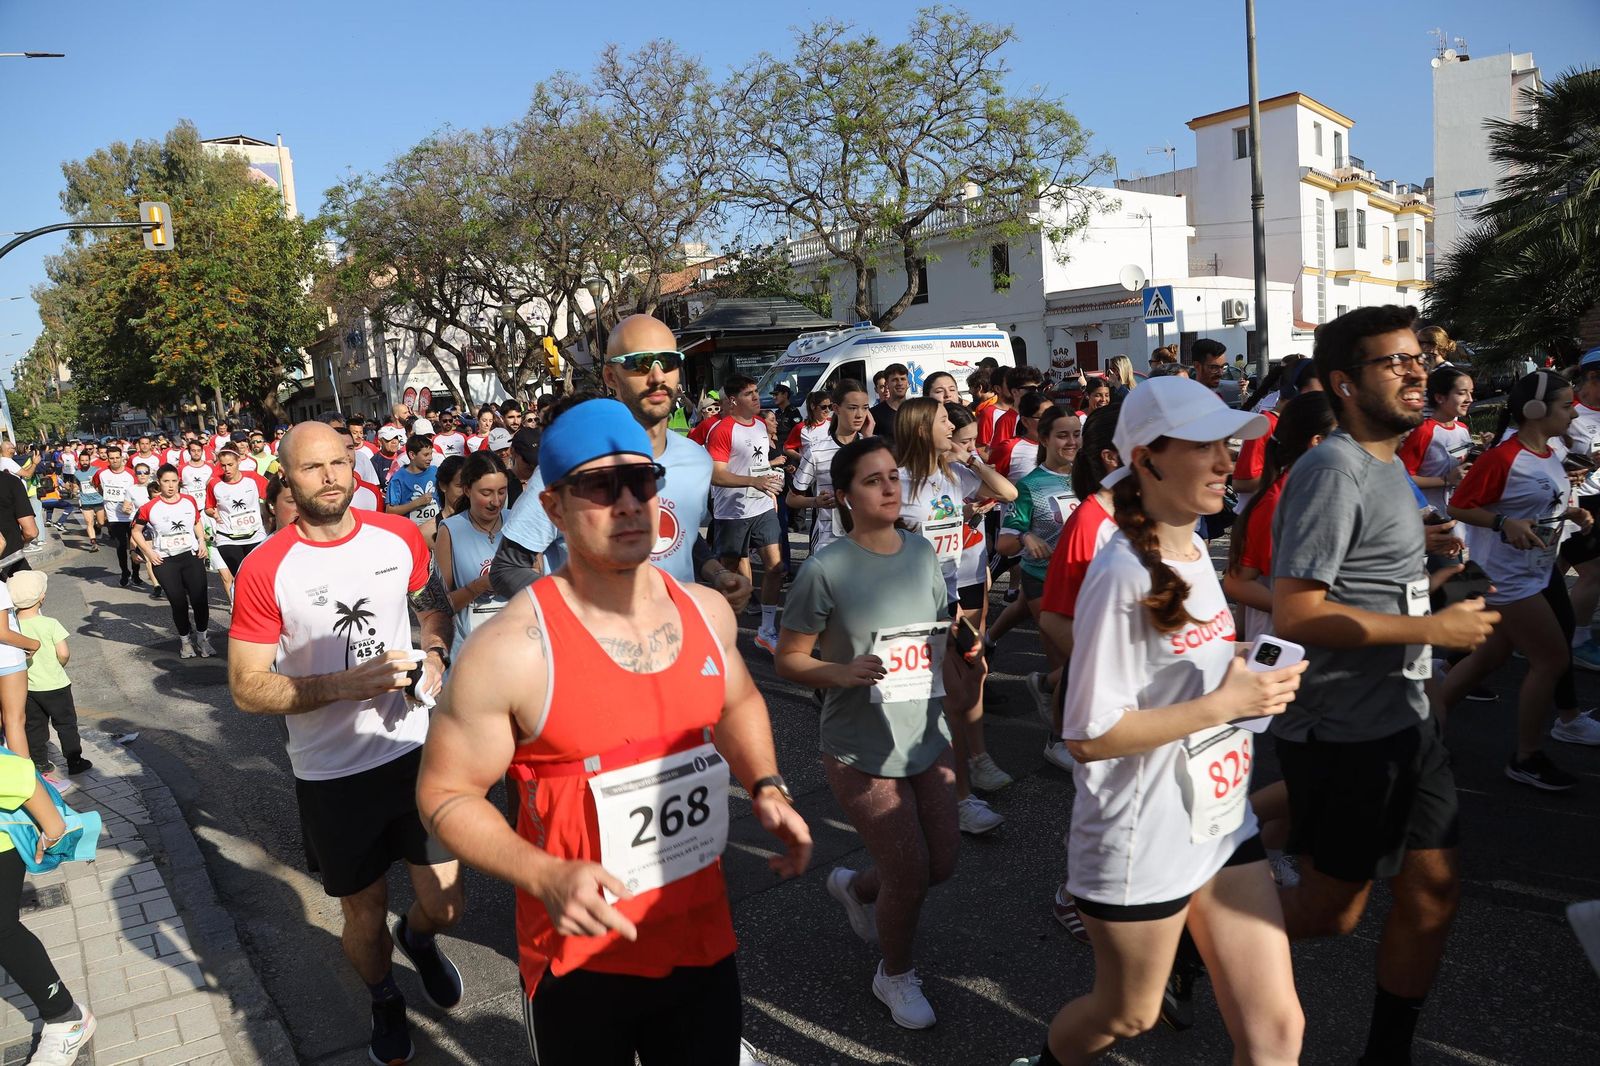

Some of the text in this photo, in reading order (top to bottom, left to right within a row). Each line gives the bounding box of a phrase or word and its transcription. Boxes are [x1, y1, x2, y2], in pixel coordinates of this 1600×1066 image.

[950, 340, 1000, 349] AMBULANCIA
[1053, 348, 1069, 356] BAR
[106, 488, 121, 496] 428
[416, 508, 436, 519] 260
[236, 515, 256, 526] 660
[933, 533, 959, 554] 773
[358, 639, 375, 649] PALO
[357, 646, 373, 658] 45
[889, 643, 932, 673] 509
[629, 785, 710, 848] 268
